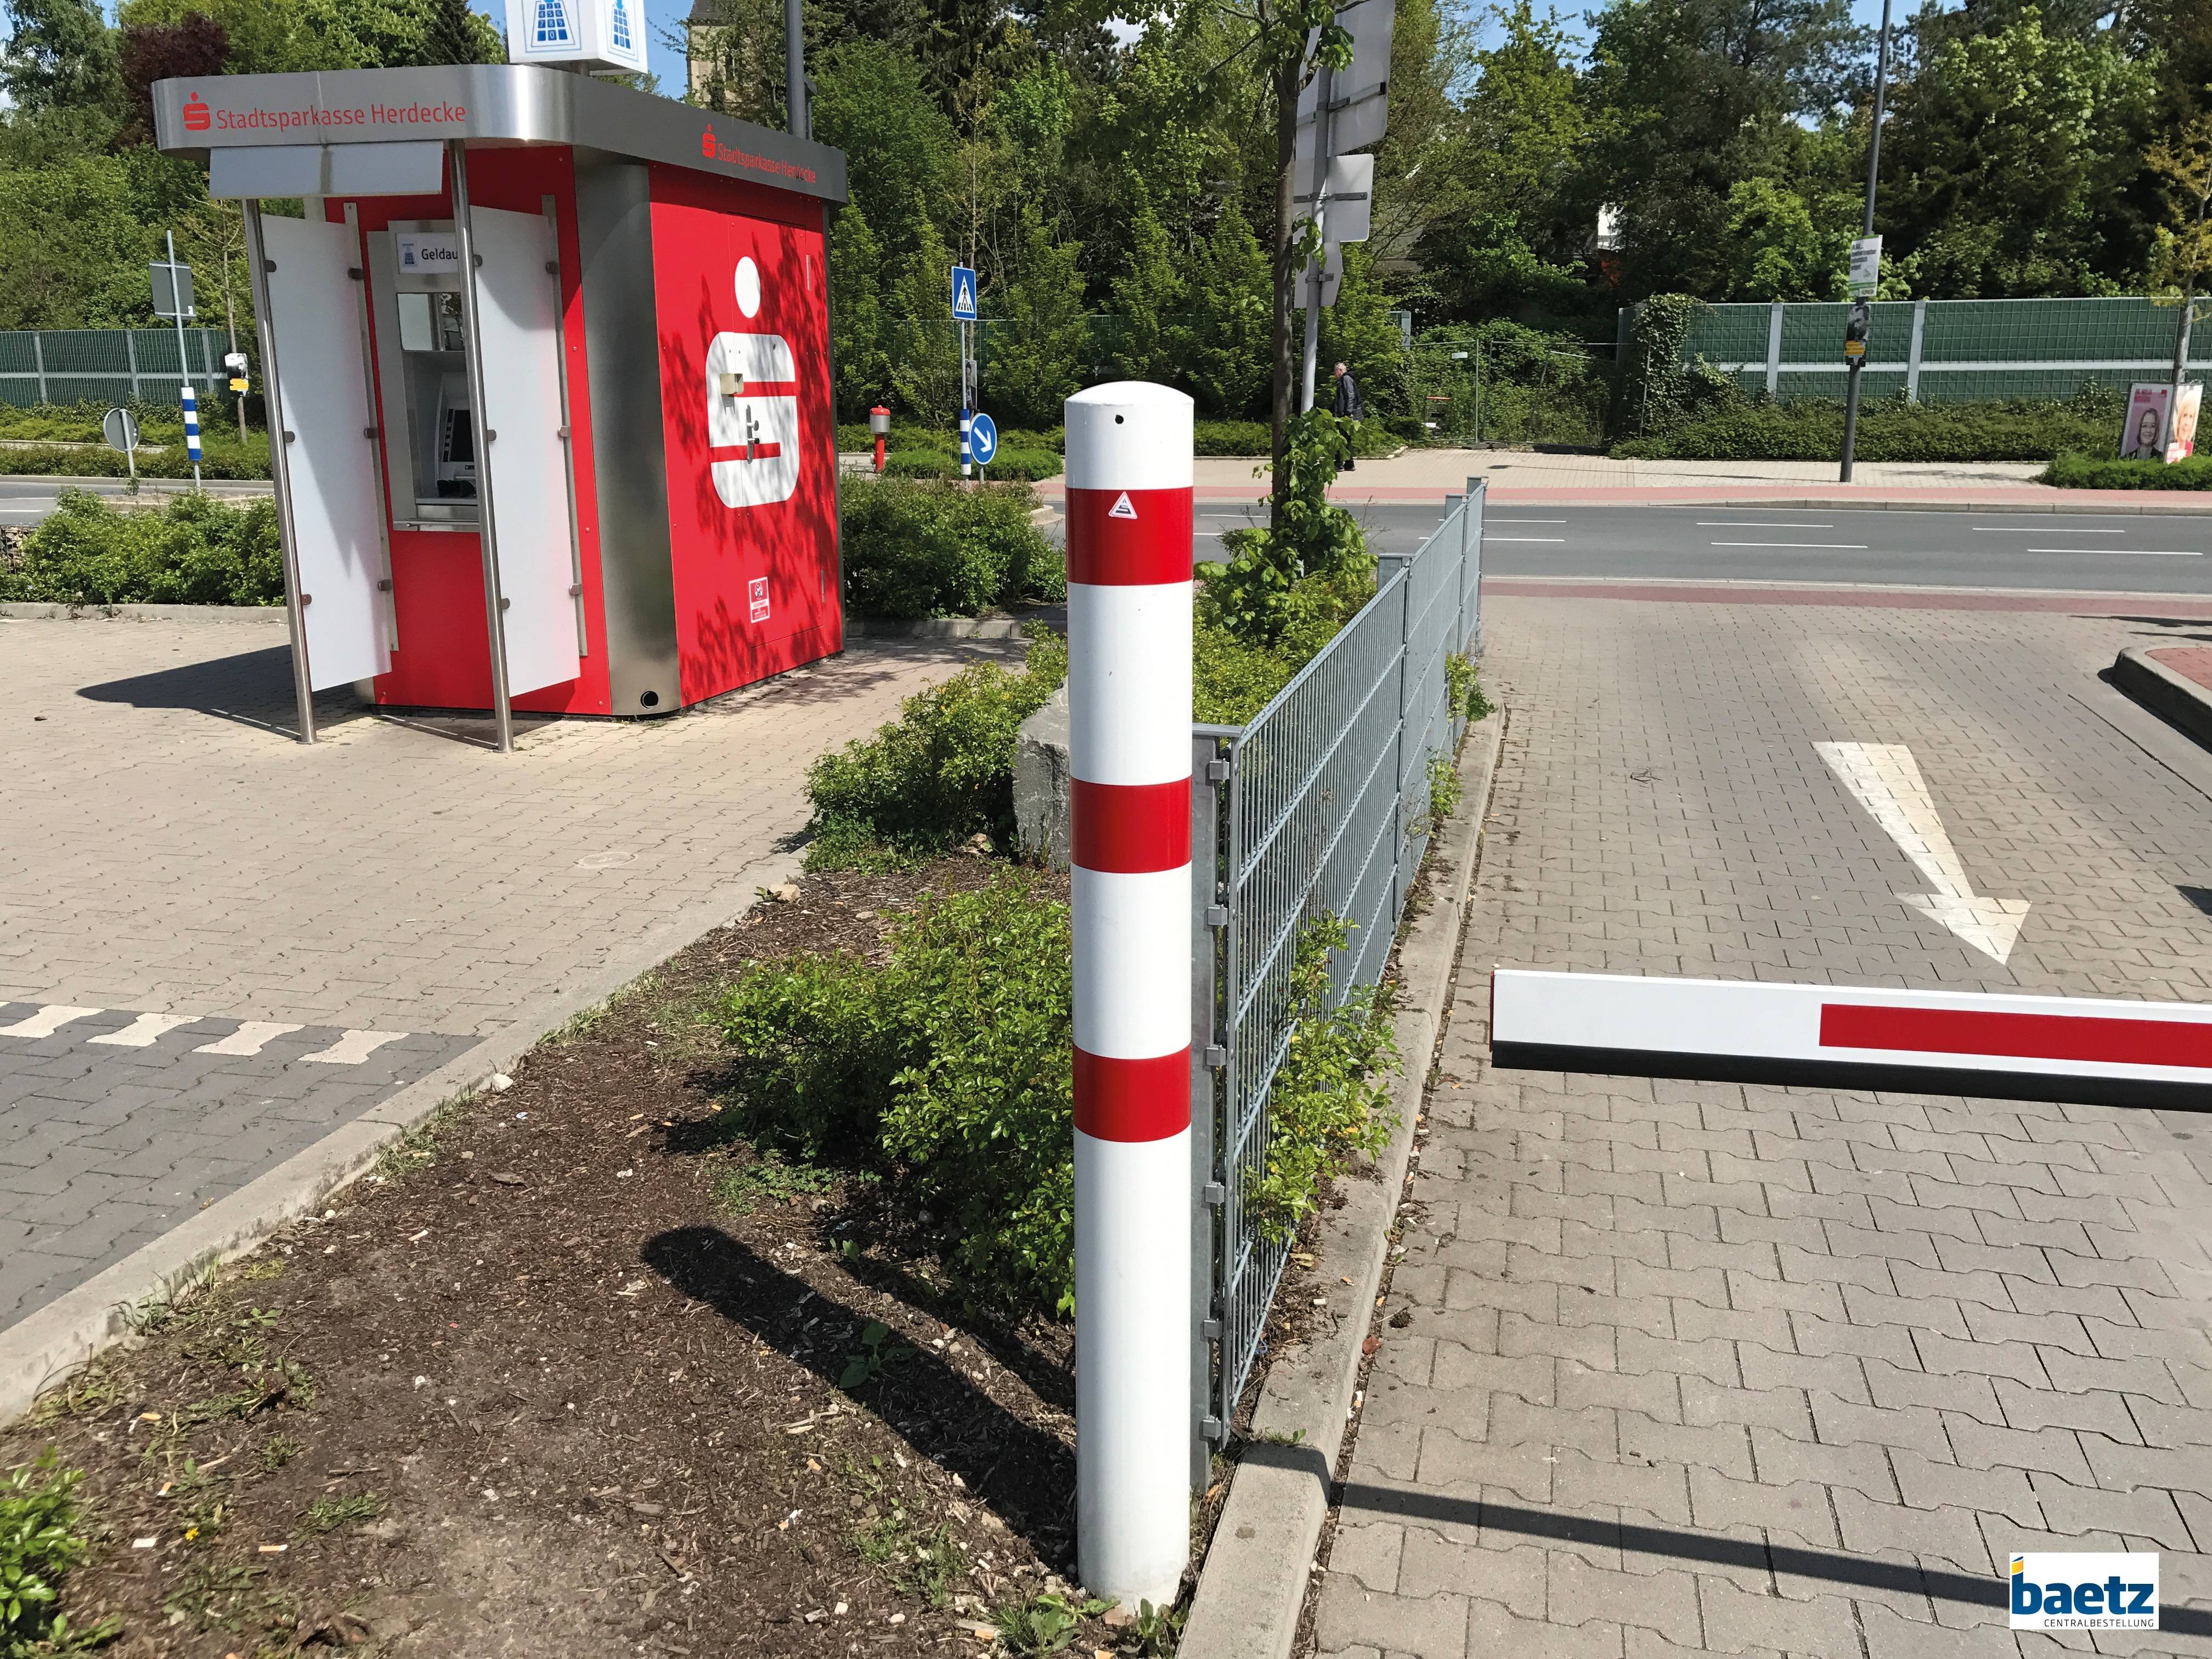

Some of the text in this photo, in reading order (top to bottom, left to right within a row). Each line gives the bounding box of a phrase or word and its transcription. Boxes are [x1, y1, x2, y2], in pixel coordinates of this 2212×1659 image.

[550, 31, 555, 39] 0
[216, 105, 365, 132] Stadtsparkasse
[371, 101, 466, 124] Herdecke
